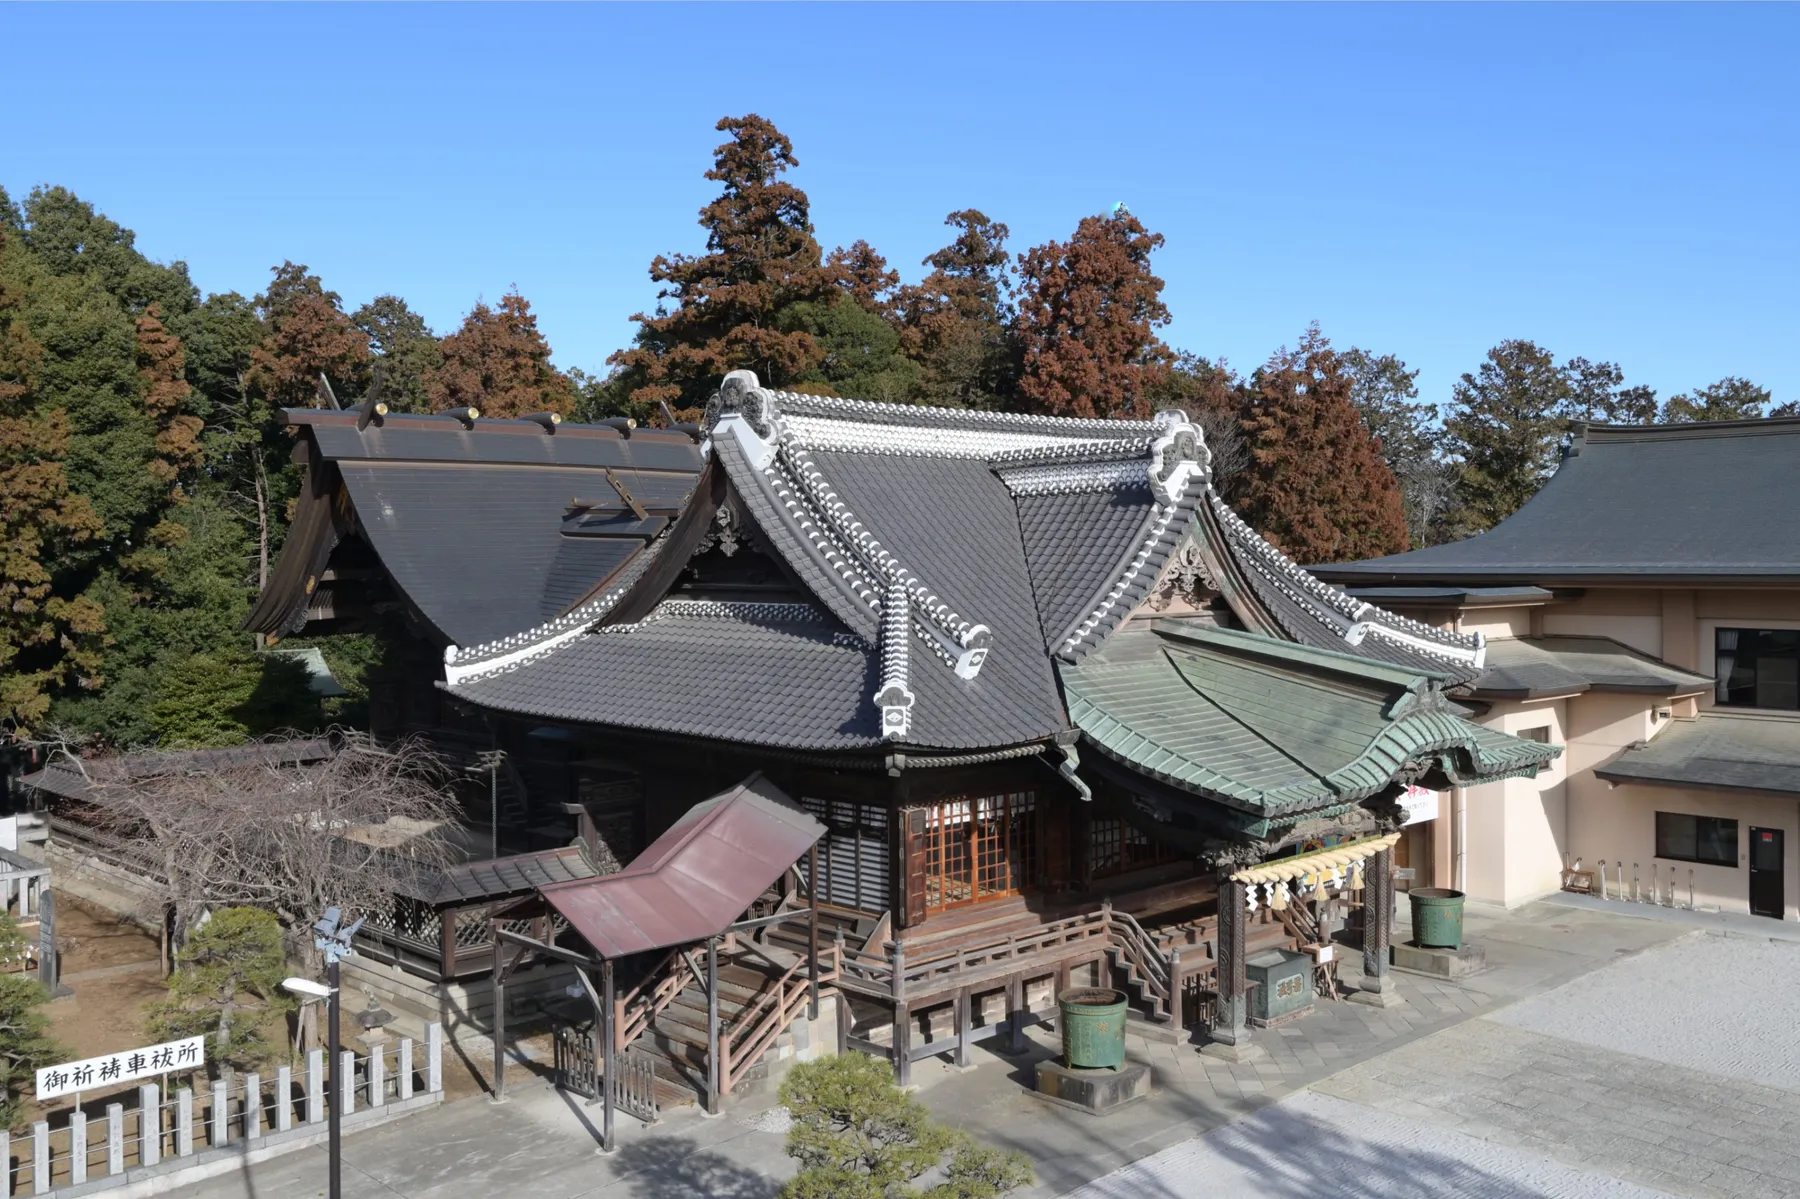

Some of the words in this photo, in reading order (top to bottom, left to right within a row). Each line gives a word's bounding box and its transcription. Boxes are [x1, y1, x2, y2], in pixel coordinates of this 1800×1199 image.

[43, 1042, 199, 1092] 御祈祷車祓所
